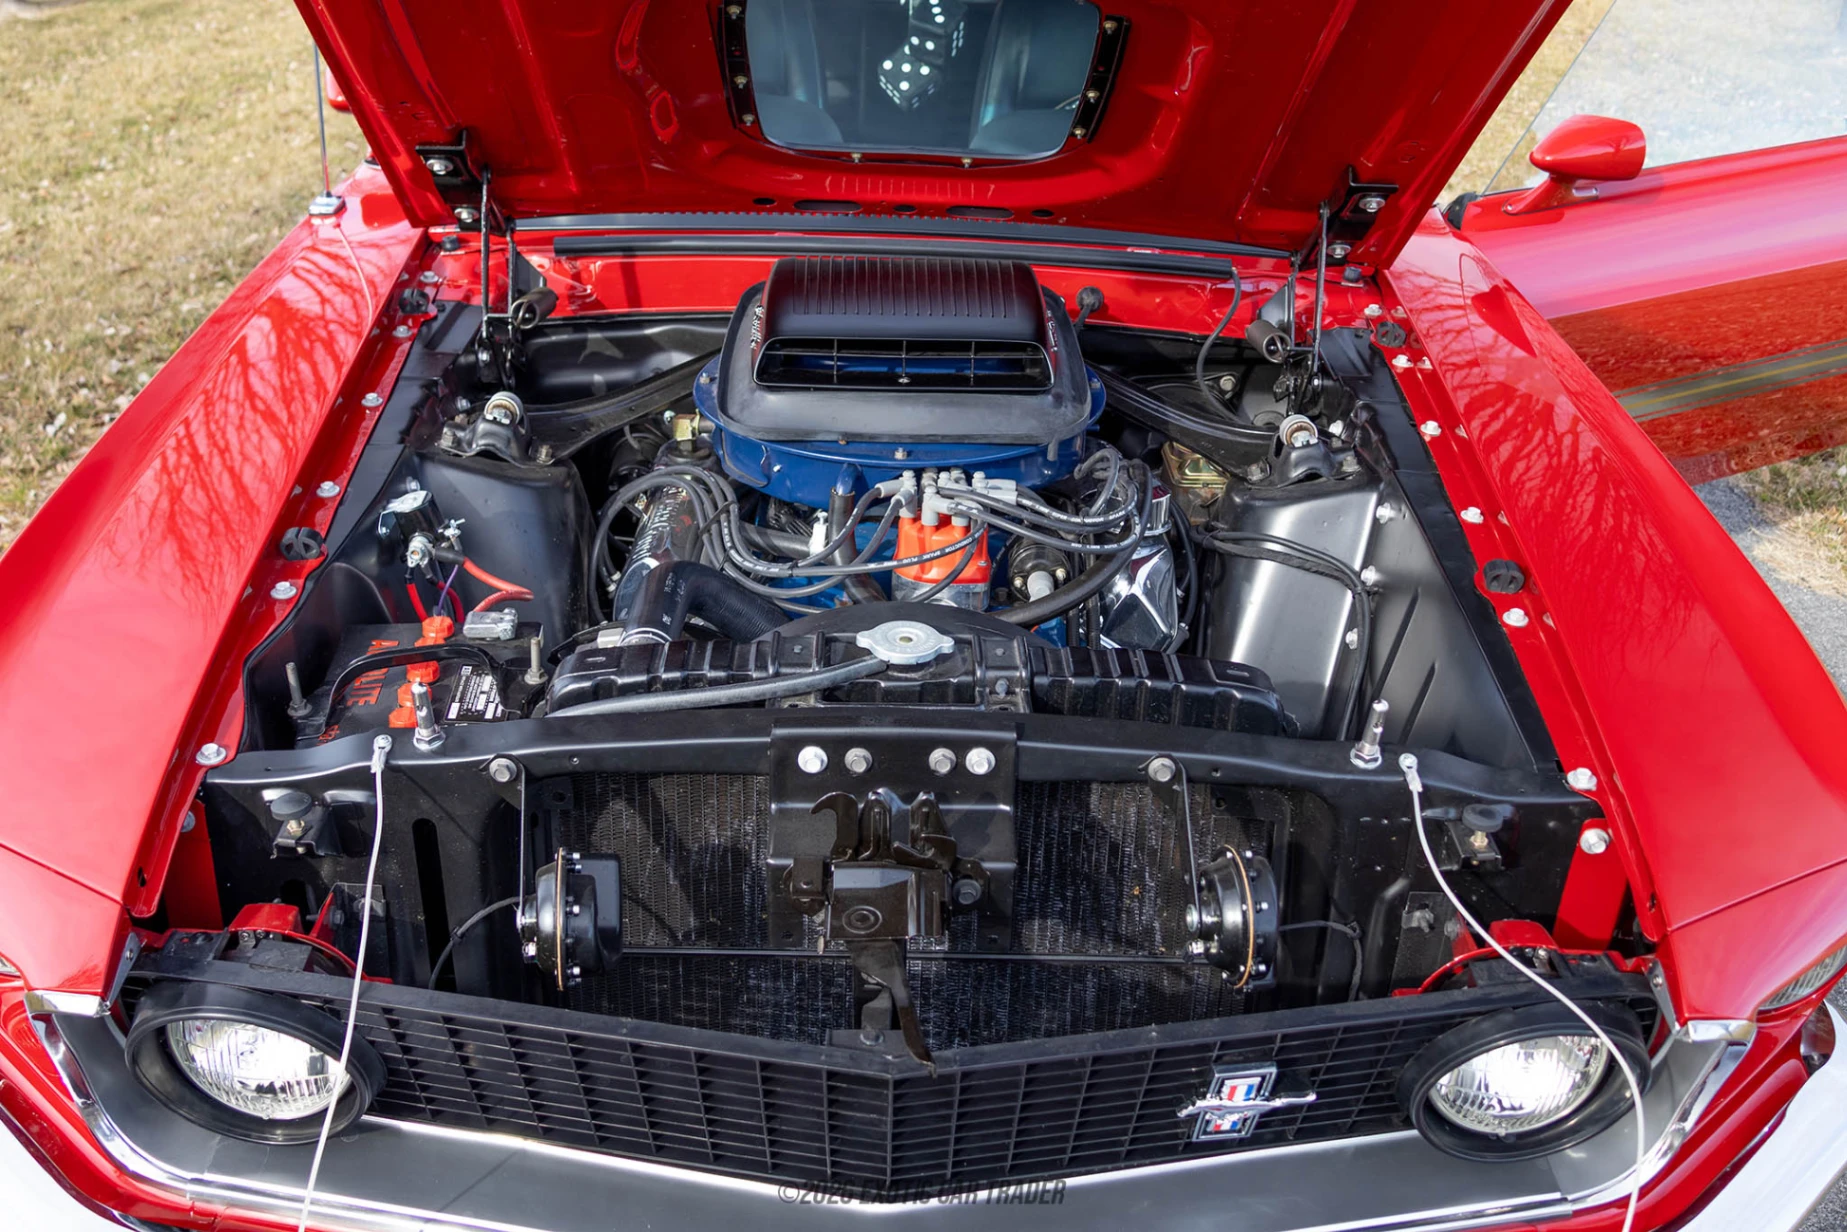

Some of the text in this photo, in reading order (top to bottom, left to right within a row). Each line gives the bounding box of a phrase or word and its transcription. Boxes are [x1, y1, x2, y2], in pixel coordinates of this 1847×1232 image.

[945, 537, 973, 553] CONDUCTOR
[922, 551, 941, 559] SPARK
[346, 639, 399, 707] AOLITE
